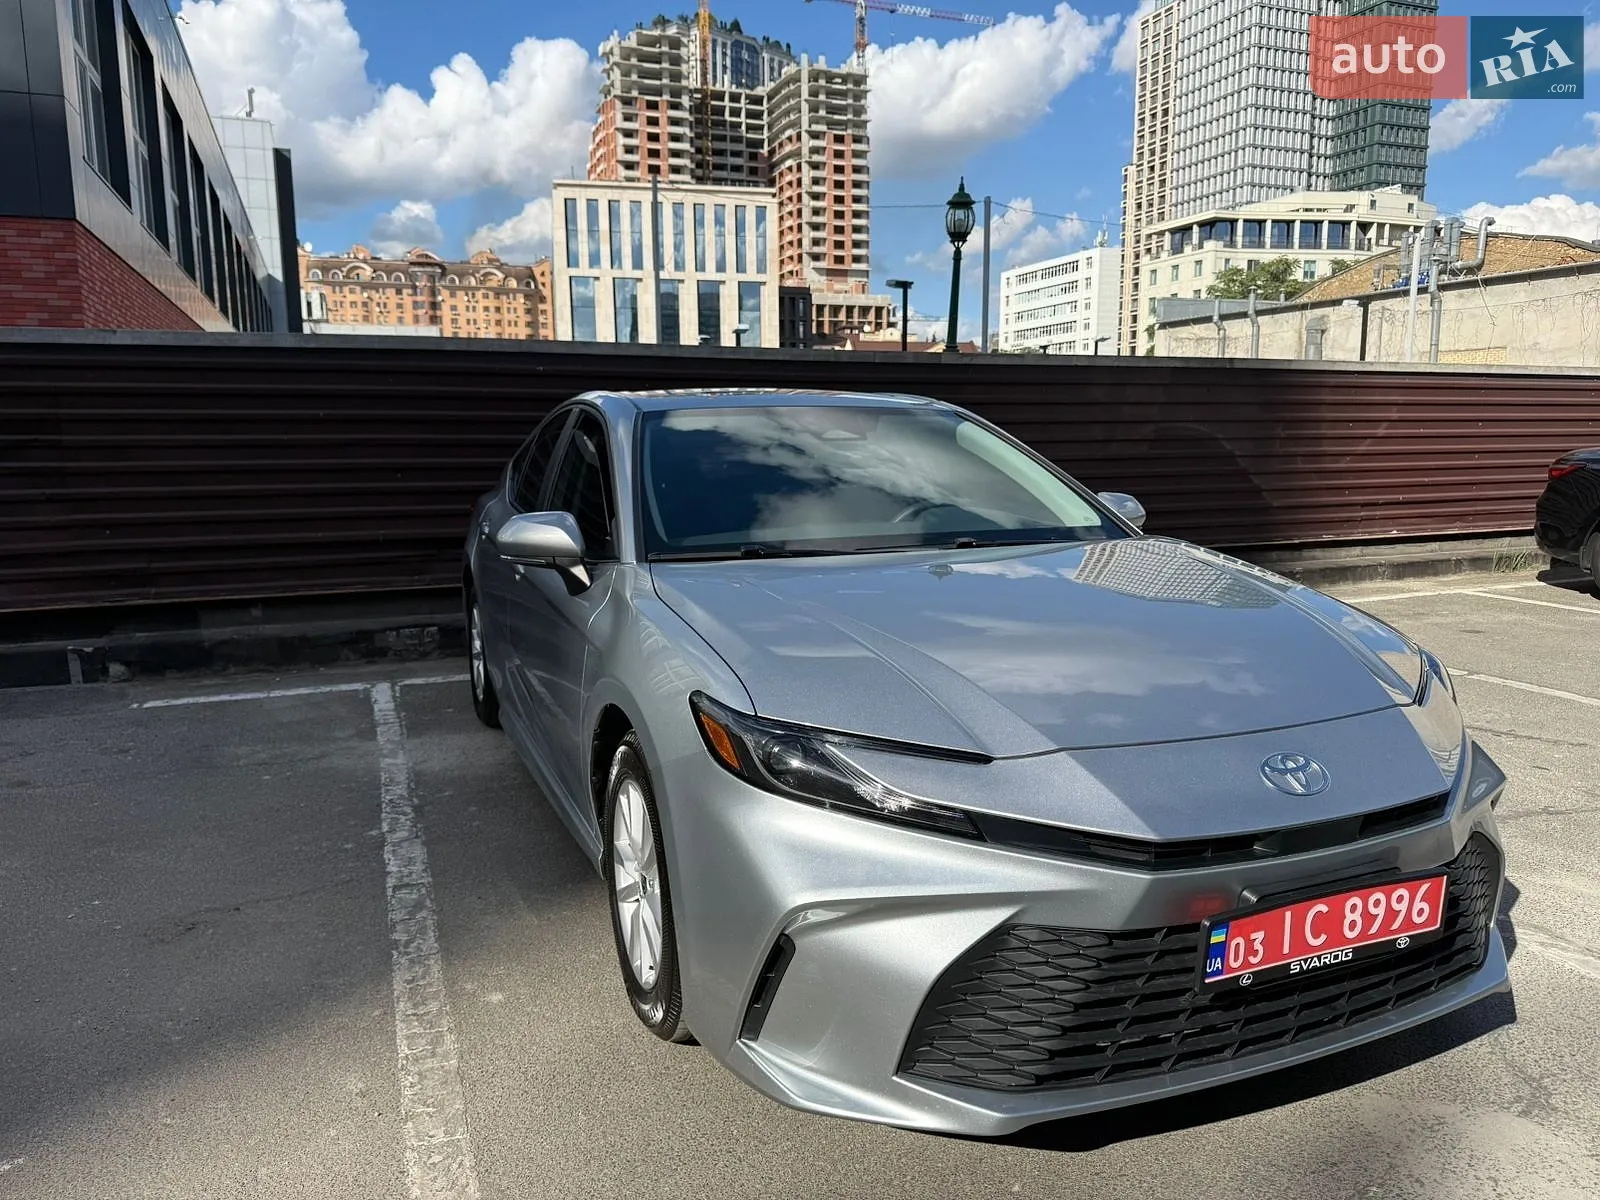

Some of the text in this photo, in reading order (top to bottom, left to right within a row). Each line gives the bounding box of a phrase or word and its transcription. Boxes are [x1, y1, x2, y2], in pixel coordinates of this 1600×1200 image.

[1229, 883, 1432, 969] 03 IC 8996
[1206, 959, 1222, 973] UA
[1290, 949, 1353, 974] SVAROG
